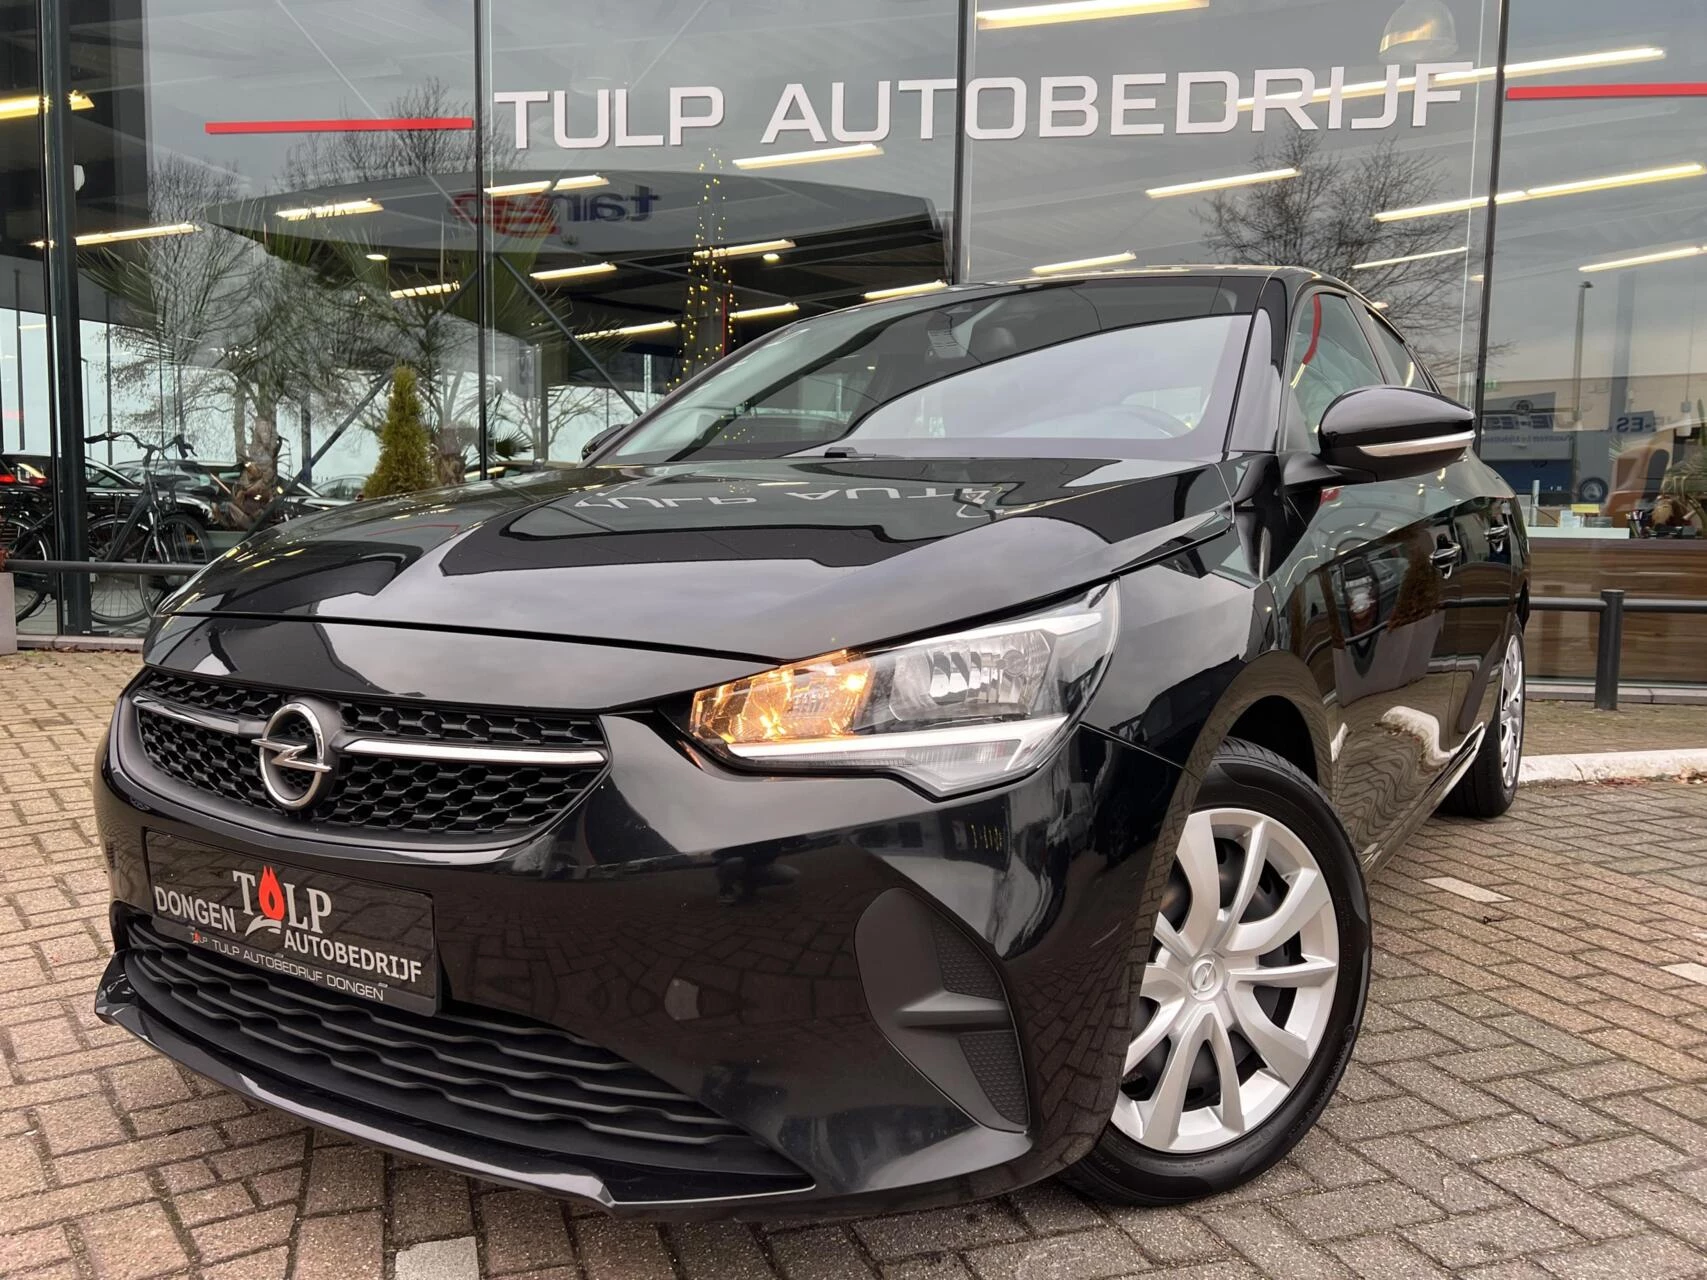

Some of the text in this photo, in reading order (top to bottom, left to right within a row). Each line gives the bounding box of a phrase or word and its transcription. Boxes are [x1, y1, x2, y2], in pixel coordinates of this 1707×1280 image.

[494, 60, 1474, 149] TULP AUTOBEDRIJF
[154, 885, 237, 934] DONGEN
[211, 939, 241, 956] TULP
[243, 949, 323, 983] AUTOBEDRIJF
[326, 973, 385, 1001] DONGEN
[284, 929, 423, 983] AUTOBEDRIJF
